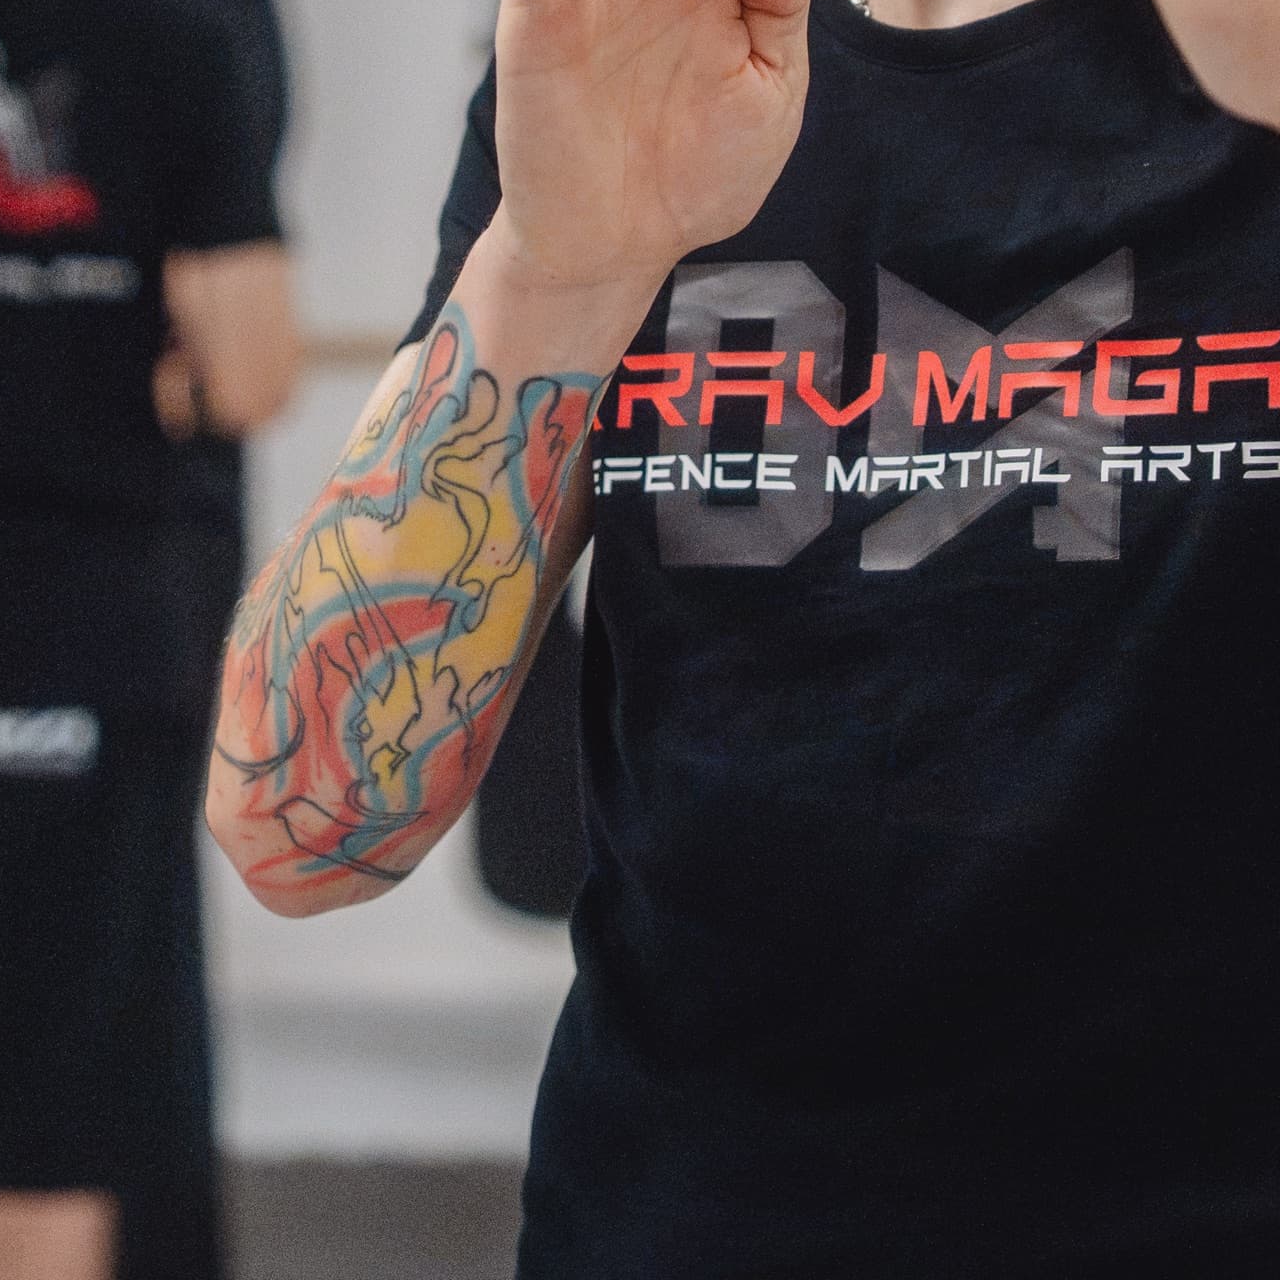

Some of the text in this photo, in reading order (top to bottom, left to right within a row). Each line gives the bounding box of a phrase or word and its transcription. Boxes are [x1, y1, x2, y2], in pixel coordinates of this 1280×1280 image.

[593, 351, 888, 431] RAV
[592, 452, 800, 495] FENCE
[825, 447, 1072, 493] MARTIAL
